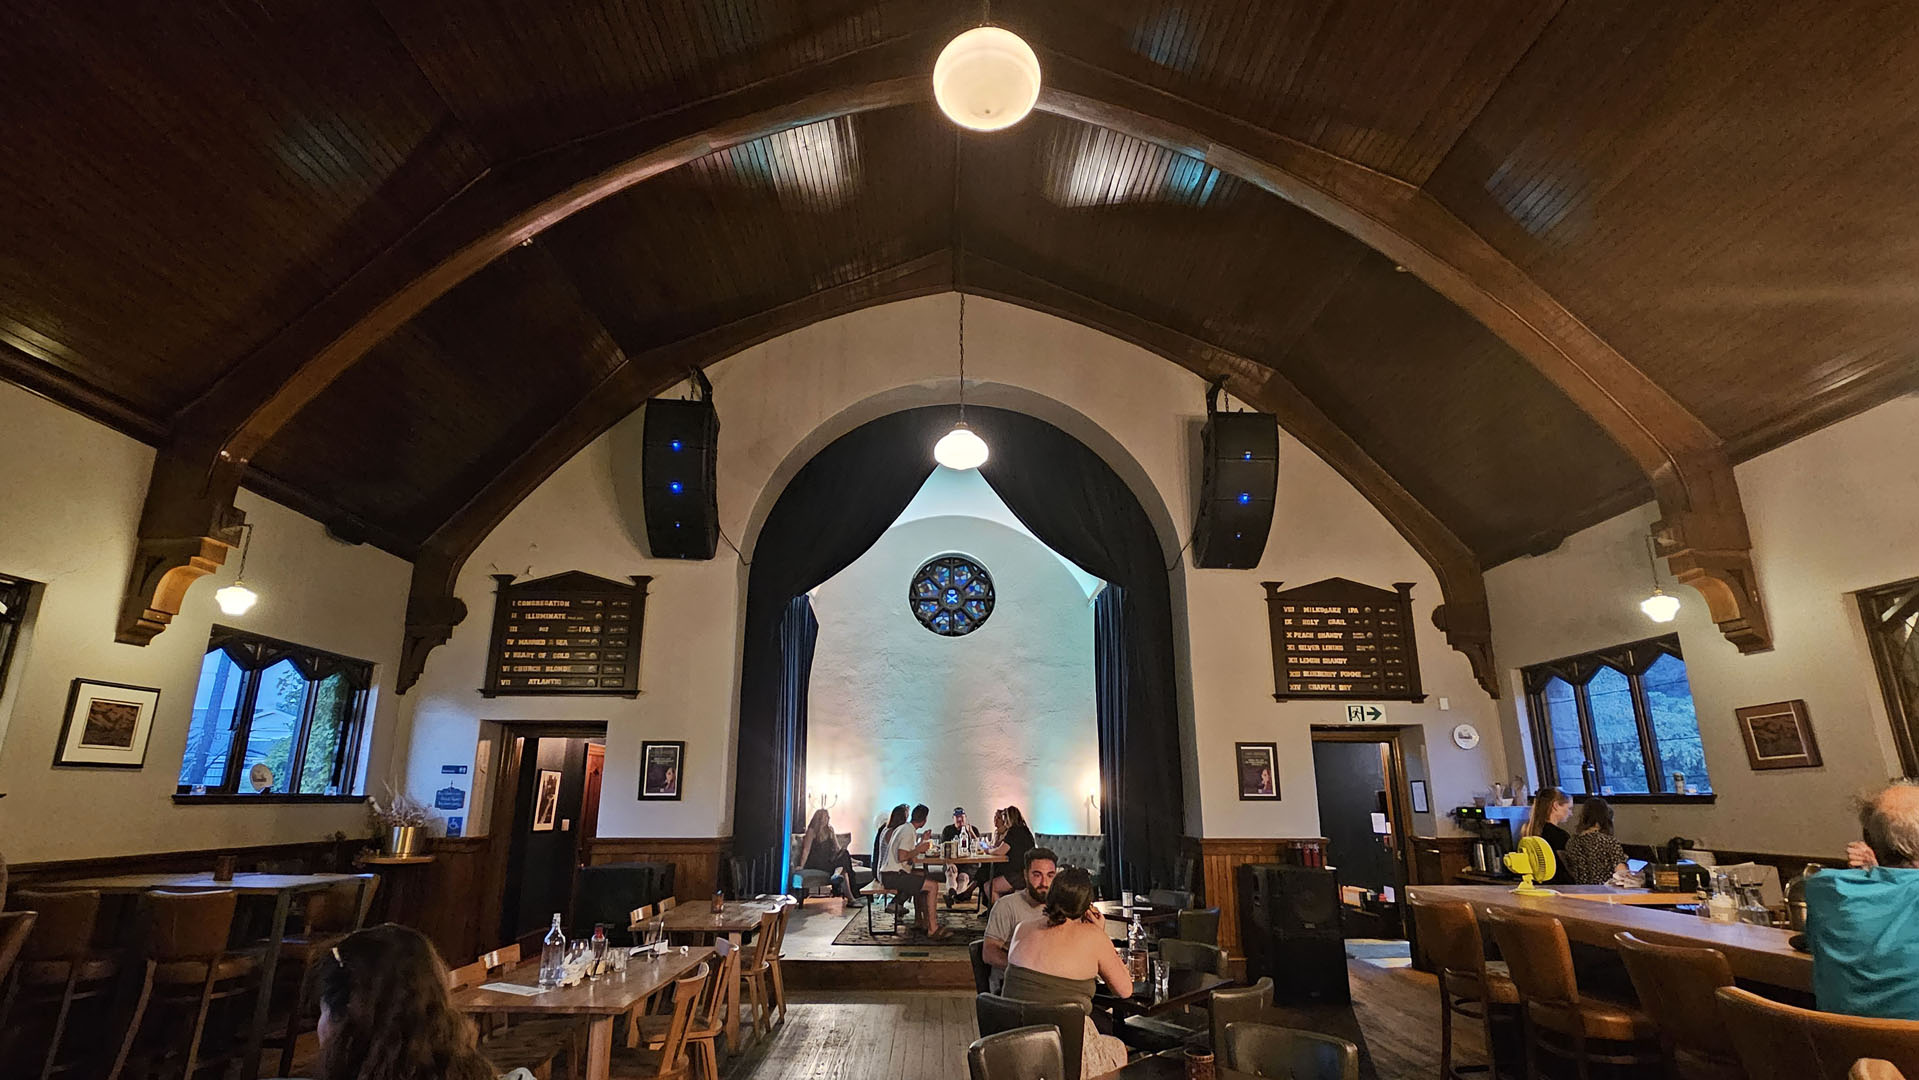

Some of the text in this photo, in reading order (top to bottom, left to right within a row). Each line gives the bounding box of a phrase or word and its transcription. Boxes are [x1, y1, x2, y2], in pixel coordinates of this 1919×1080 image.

[525, 612, 567, 620] ILLUMINATE
[578, 625, 591, 633] IPA
[512, 651, 536, 659] HEART
[1302, 670, 1337, 678] BLUEBERRY
